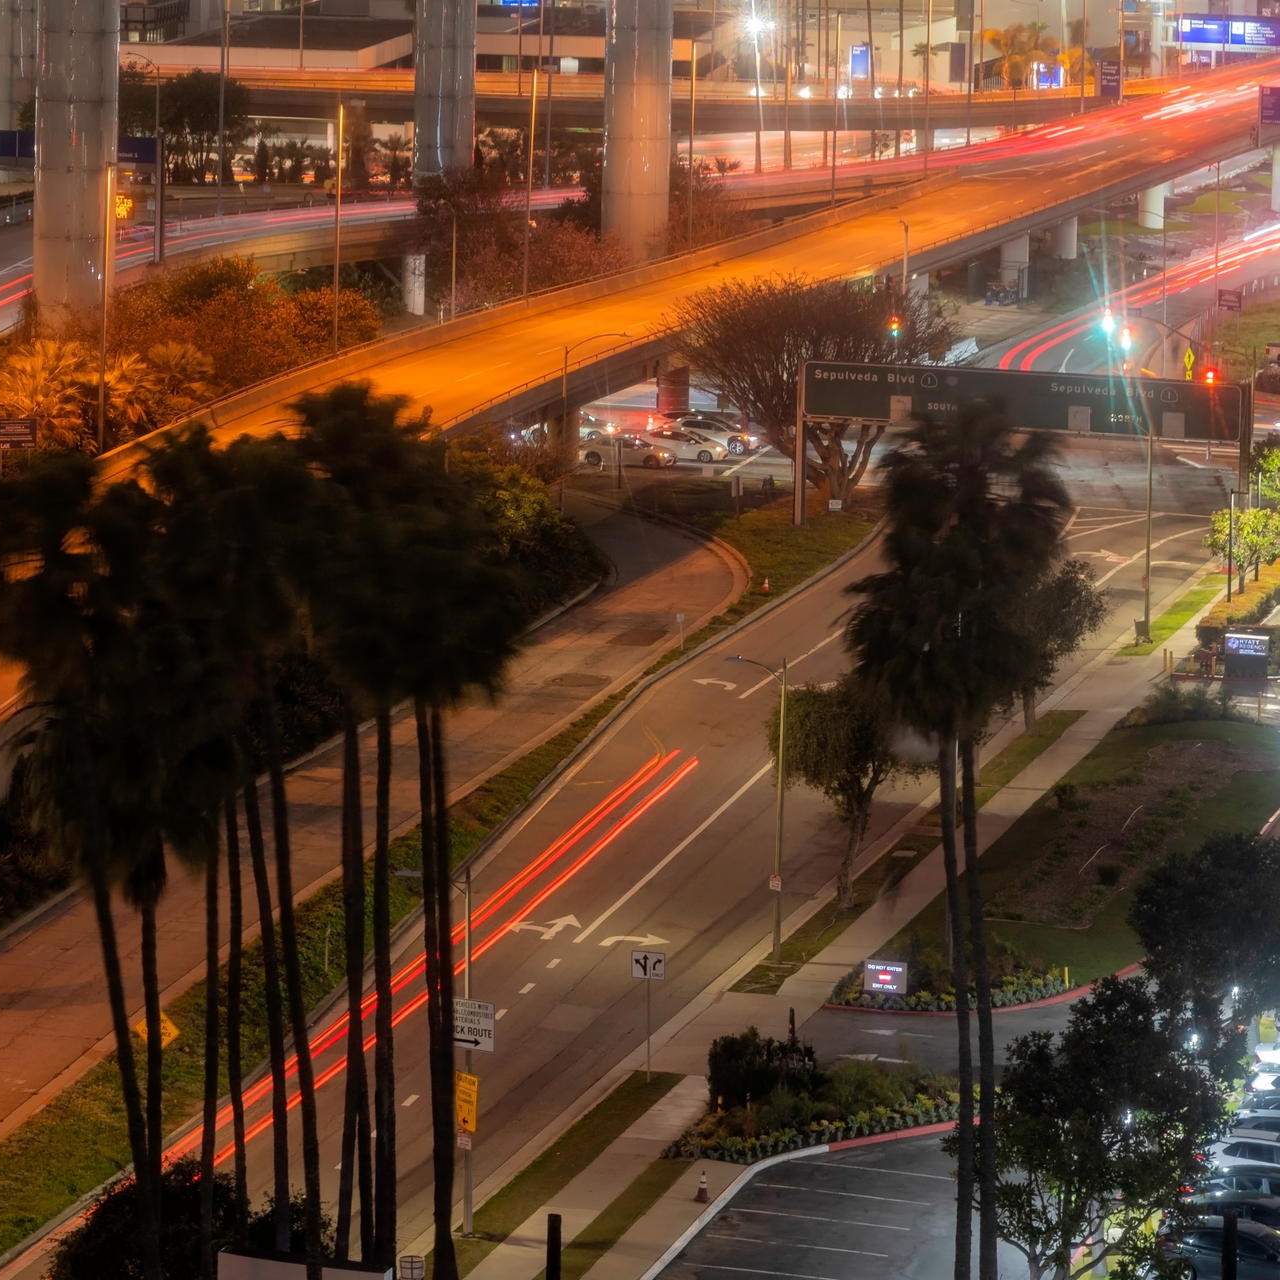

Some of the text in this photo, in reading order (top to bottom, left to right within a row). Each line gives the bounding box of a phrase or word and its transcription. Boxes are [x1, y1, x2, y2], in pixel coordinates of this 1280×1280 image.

[814, 370, 878, 382] Sepulveda
[887, 373, 915, 384] Blvd
[1050, 382, 1116, 397] Sepulveda
[1126, 388, 1154, 398] Blvd
[927, 402, 959, 412] SOUTH
[454, 1016, 481, 1025] ATERIALS
[468, 1026, 493, 1039] ROUTE
